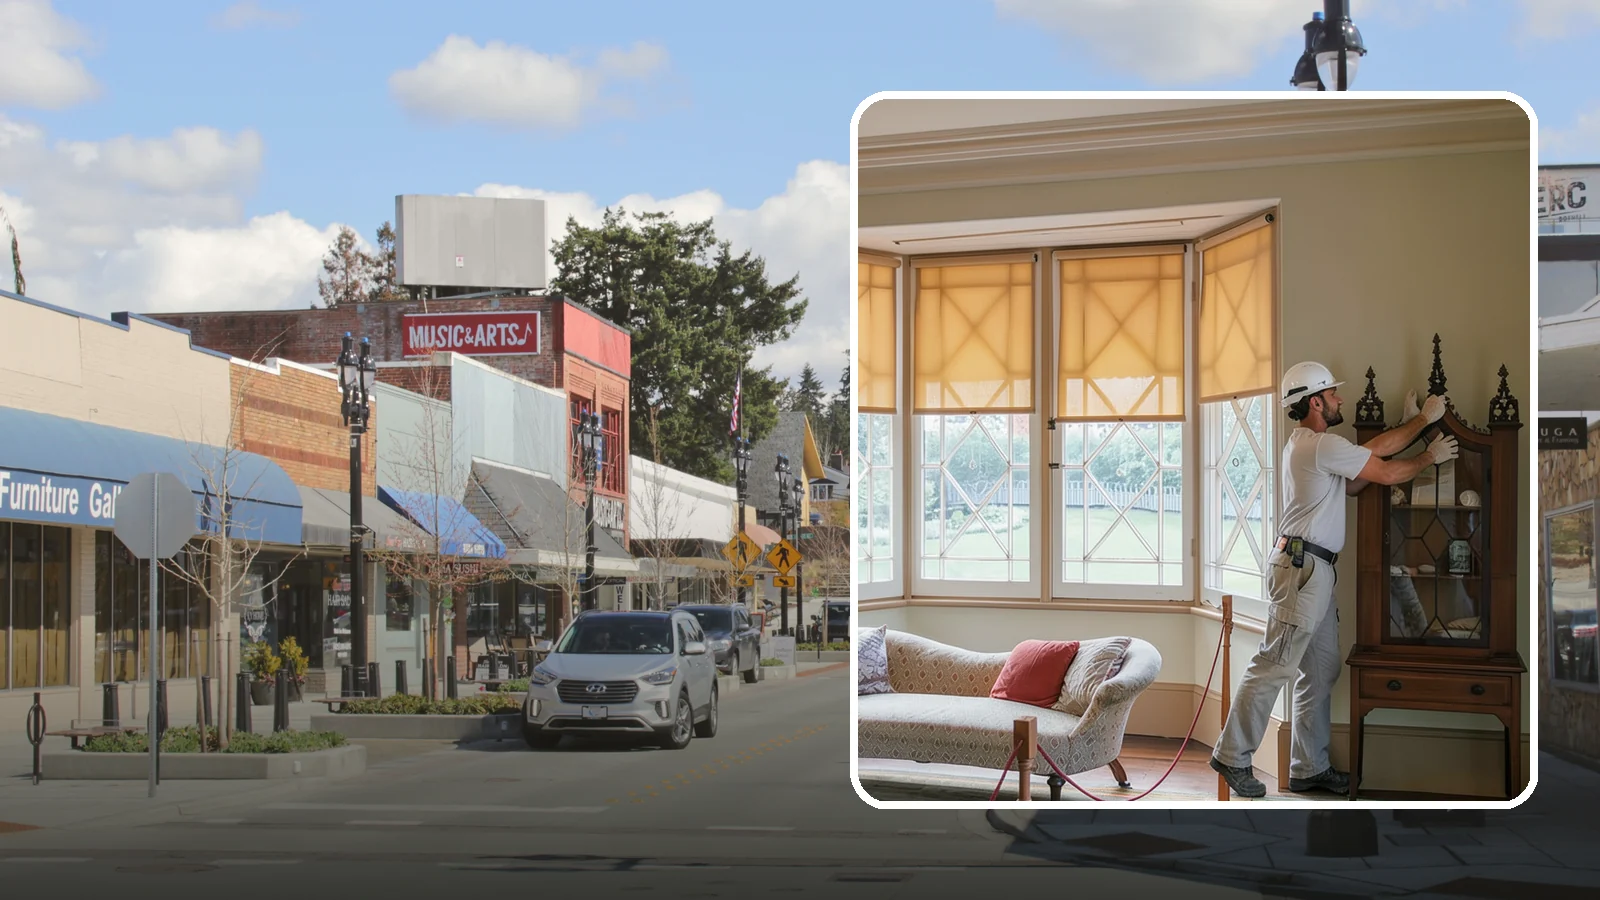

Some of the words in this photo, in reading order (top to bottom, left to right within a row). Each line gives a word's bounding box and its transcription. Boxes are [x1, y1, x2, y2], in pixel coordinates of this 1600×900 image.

[408, 322, 520, 349] MUSIC&ARTS
[0, 471, 79, 515] Furniture
[89, 482, 122, 519] Gal
